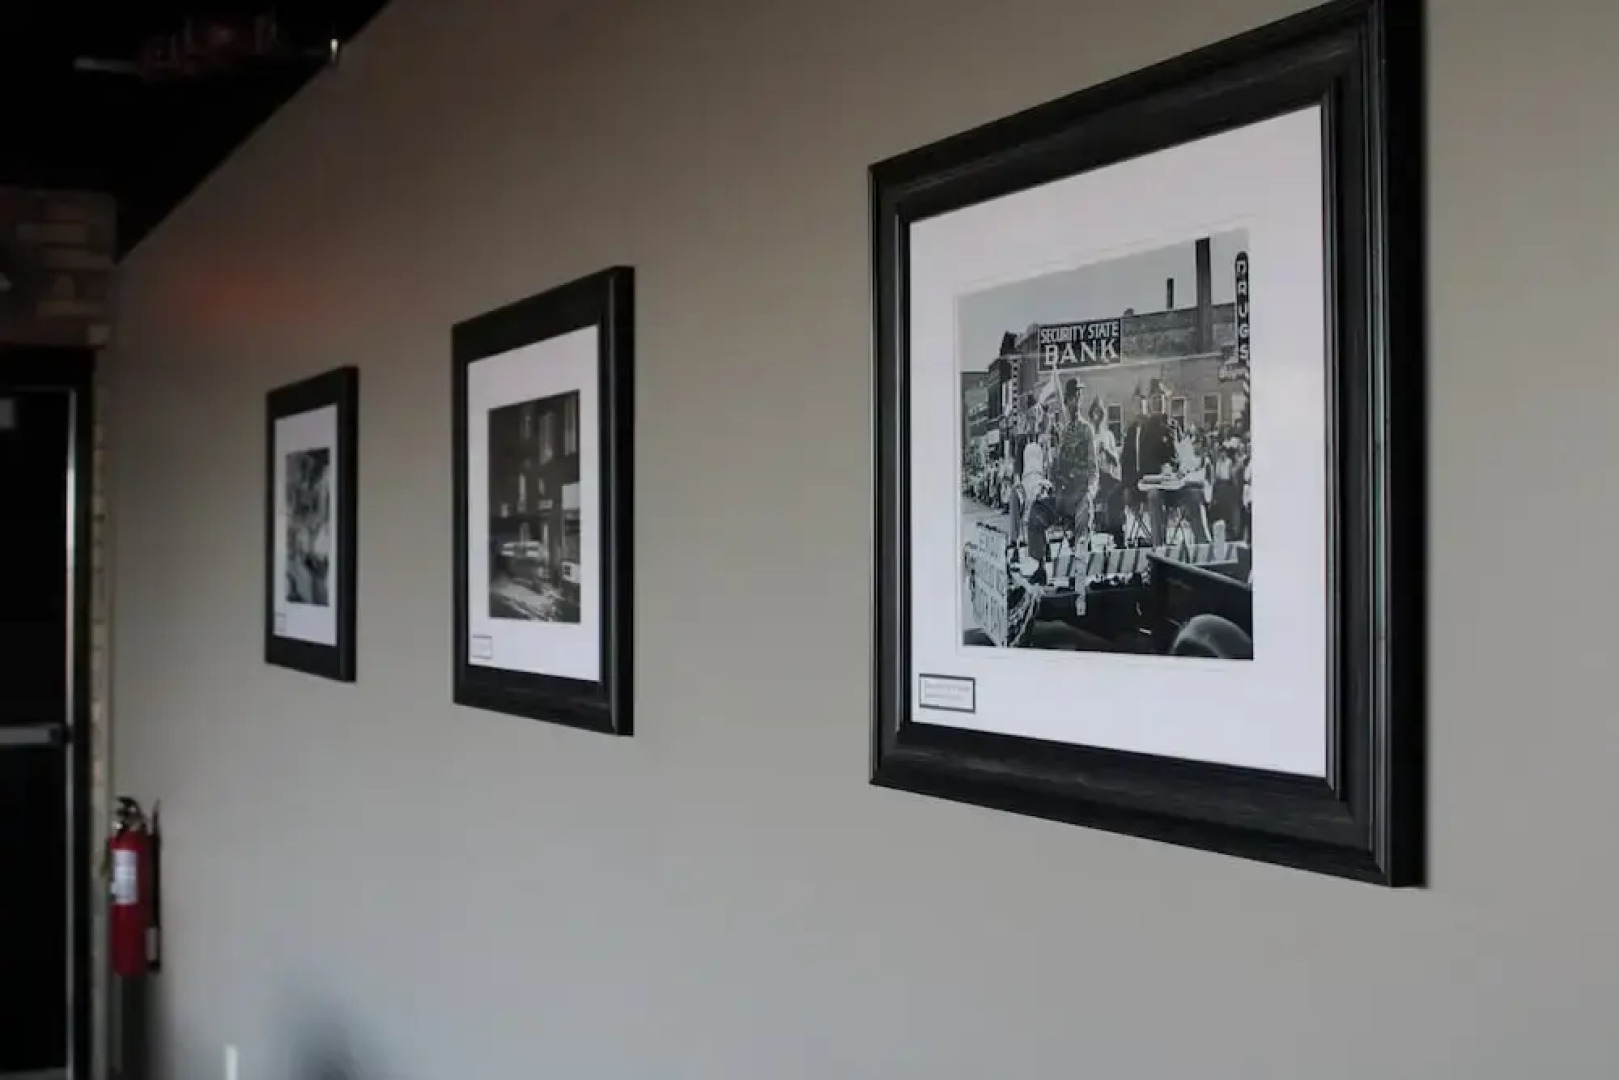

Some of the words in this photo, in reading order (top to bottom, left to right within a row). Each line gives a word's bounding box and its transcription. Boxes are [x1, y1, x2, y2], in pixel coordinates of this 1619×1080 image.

[1236, 260, 1249, 360] DRUGS
[1040, 325, 1086, 343] SECURITY
[1087, 321, 1119, 339] STATE
[1044, 340, 1118, 365] BANK
